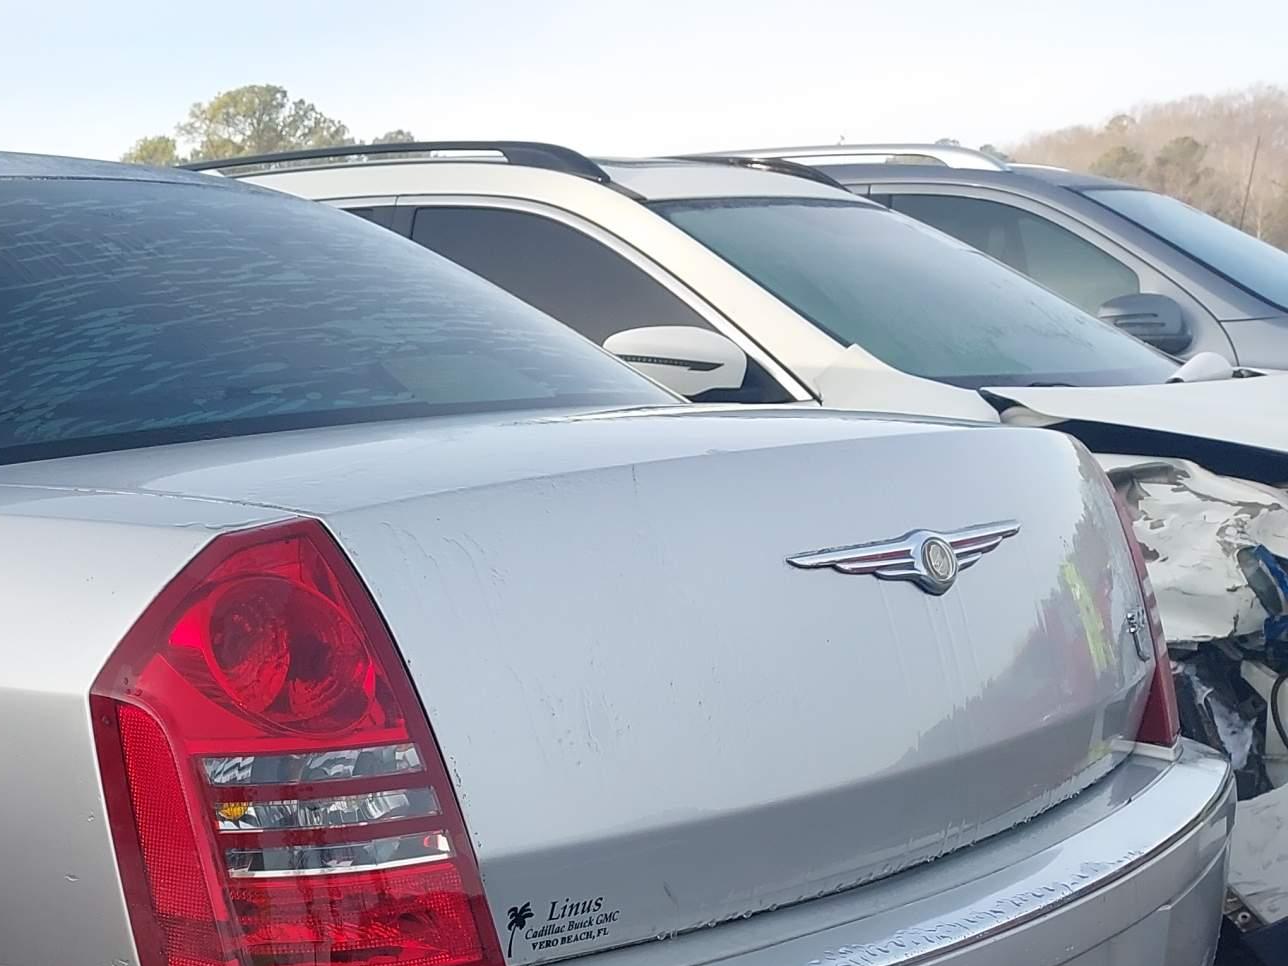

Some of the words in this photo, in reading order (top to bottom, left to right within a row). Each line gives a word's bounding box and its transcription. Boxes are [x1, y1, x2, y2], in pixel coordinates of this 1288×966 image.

[547, 897, 603, 921] Linus
[525, 923, 565, 940] Cadillac
[567, 916, 594, 931] Buick
[595, 910, 620, 925] GMC
[532, 938, 559, 951] VERO
[560, 931, 595, 946] BEACH,
[596, 928, 609, 938] FL
